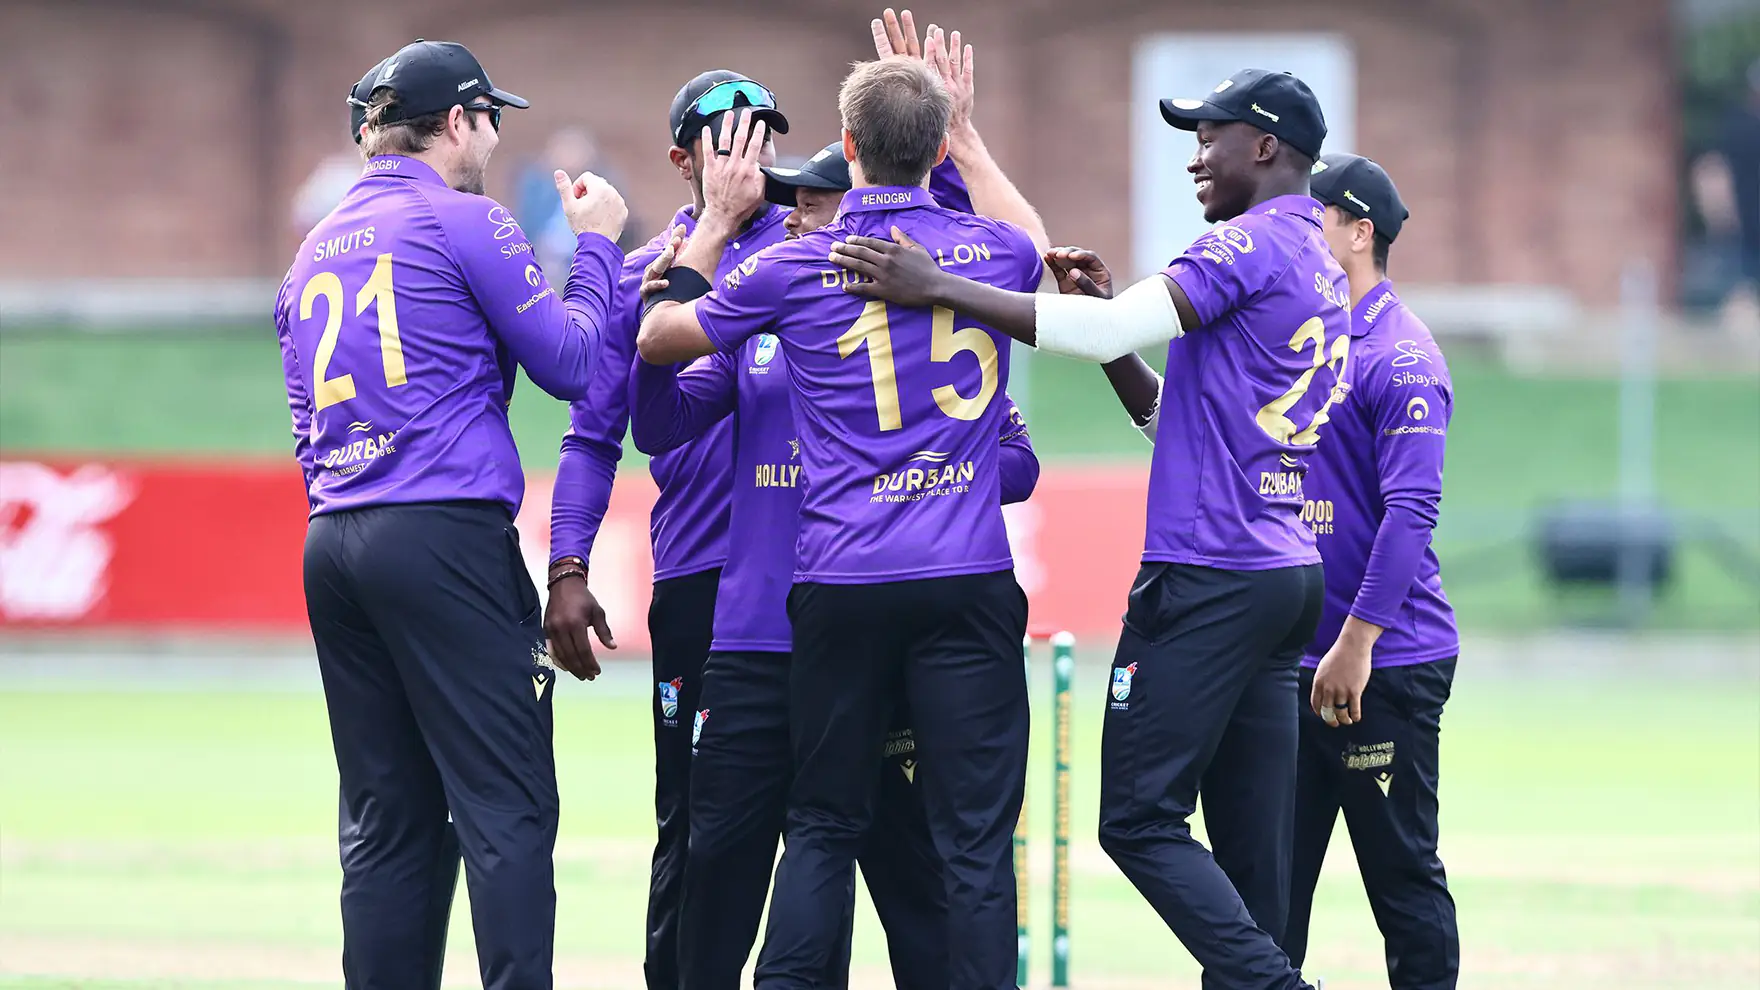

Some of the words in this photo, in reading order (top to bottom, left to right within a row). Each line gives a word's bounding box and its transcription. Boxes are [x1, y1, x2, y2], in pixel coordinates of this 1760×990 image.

[861, 192, 912, 206] #ENDGBV
[313, 226, 376, 262] SMUTS
[299, 252, 408, 413] 21
[836, 300, 999, 433] 15
[1392, 371, 1439, 388] Sibaya
[755, 463, 803, 488] HOLLY
[872, 461, 975, 495] DURBAN
[869, 494, 883, 504] THE
[884, 493, 925, 503] WARMEST
[926, 487, 950, 497] PLACE
[952, 485, 963, 494] TO
[1312, 521, 1334, 534] bets
[1347, 752, 1395, 771] Dolphins
